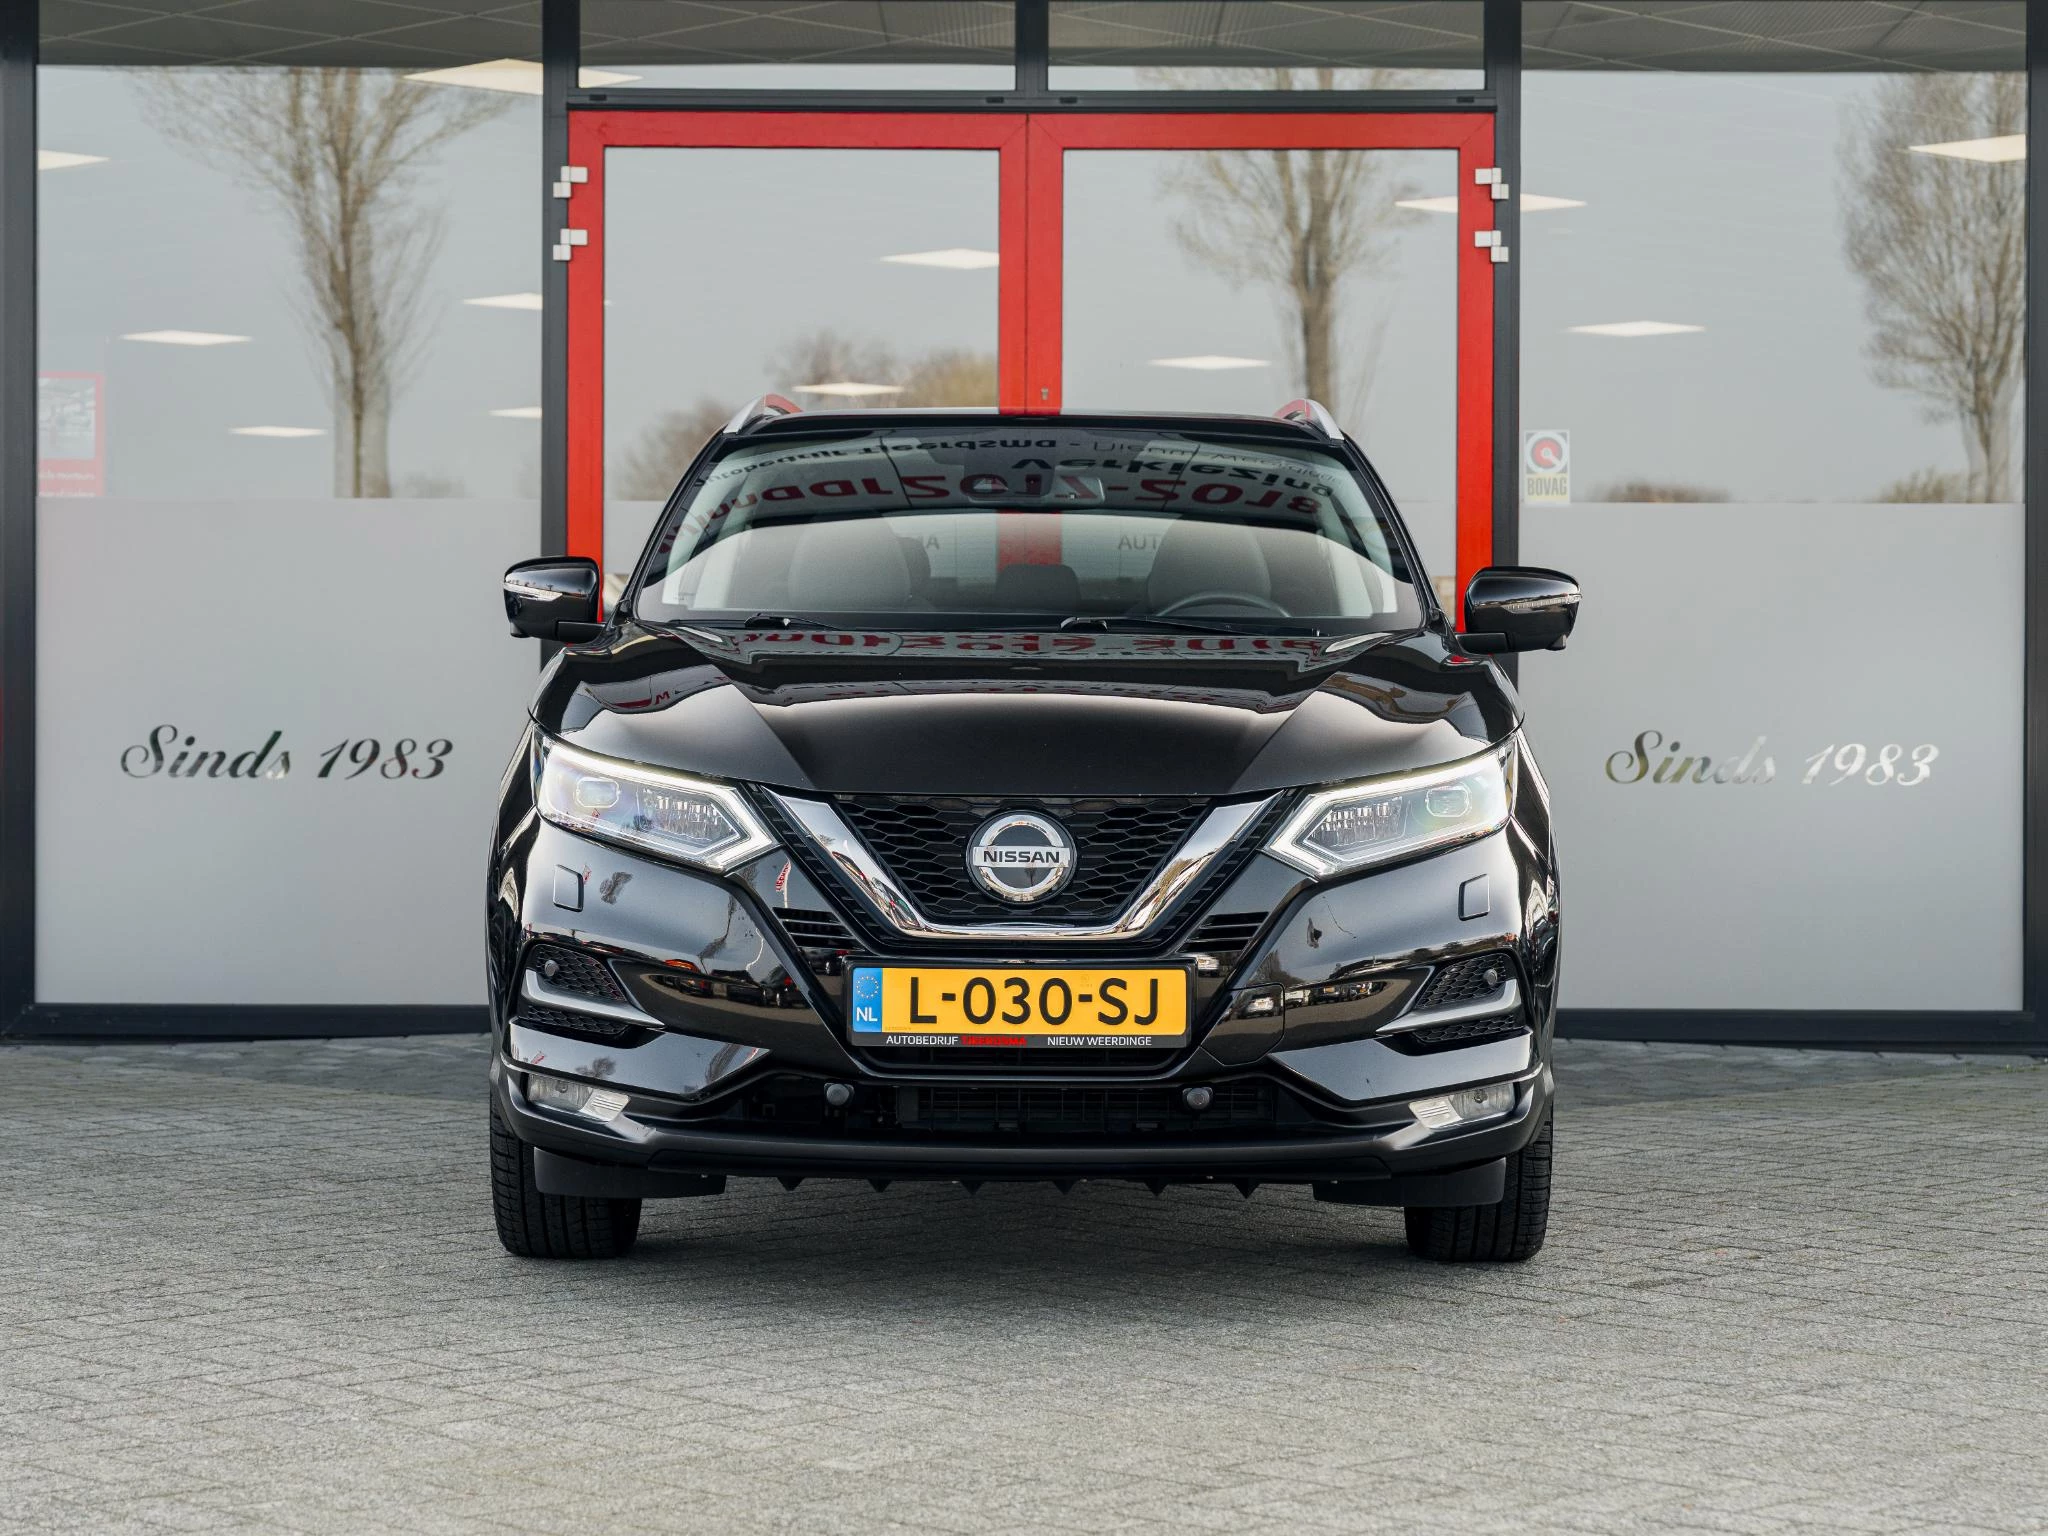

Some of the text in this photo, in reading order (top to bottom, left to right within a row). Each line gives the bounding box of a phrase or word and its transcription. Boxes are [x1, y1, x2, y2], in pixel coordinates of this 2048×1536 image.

[1527, 477, 1567, 496] BOVAG
[120, 724, 453, 780] Sinds 1983
[1605, 730, 1940, 786] Sinds 1983
[983, 851, 1060, 863] NISSAN
[909, 976, 1158, 1026] L-030-SJ
[856, 1007, 878, 1022] NL
[886, 1035, 958, 1045] AUTOBEDRIJF
[1047, 1036, 1085, 1046] NIEUW
[1086, 1036, 1152, 1046] WEERDINGE
